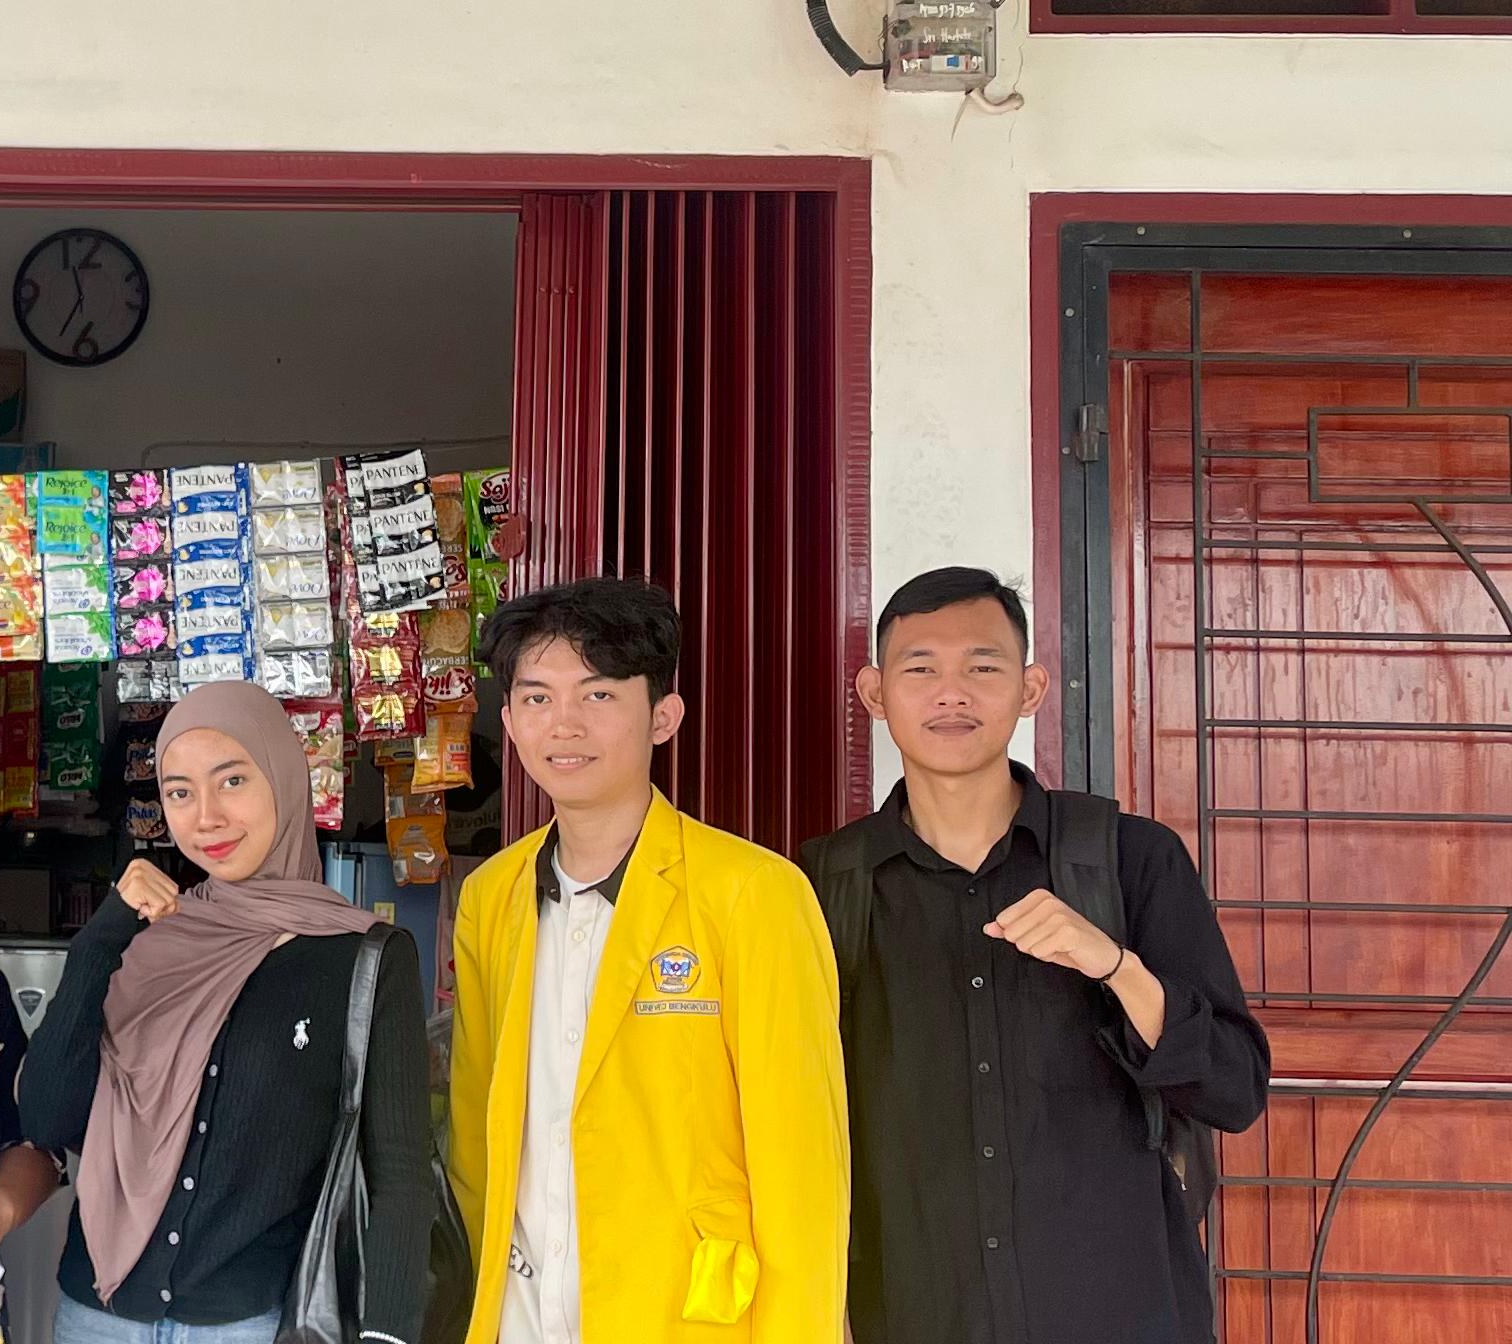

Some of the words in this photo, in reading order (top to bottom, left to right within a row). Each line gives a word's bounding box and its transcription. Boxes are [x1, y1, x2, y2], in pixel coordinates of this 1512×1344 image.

[62, 237, 104, 271] 12
[20, 278, 41, 317] 9
[71, 320, 99, 358] 6
[175, 472, 235, 487] PANTENE
[366, 463, 421, 481] PANTENE
[45, 476, 88, 490] Rejoice
[374, 509, 429, 528] PANTENE
[45, 521, 88, 535] Rejoice
[381, 557, 438, 575] PANTENE
[179, 567, 237, 582] PANTENE
[288, 582, 323, 595] Dove
[127, 806, 158, 820] Pilus
